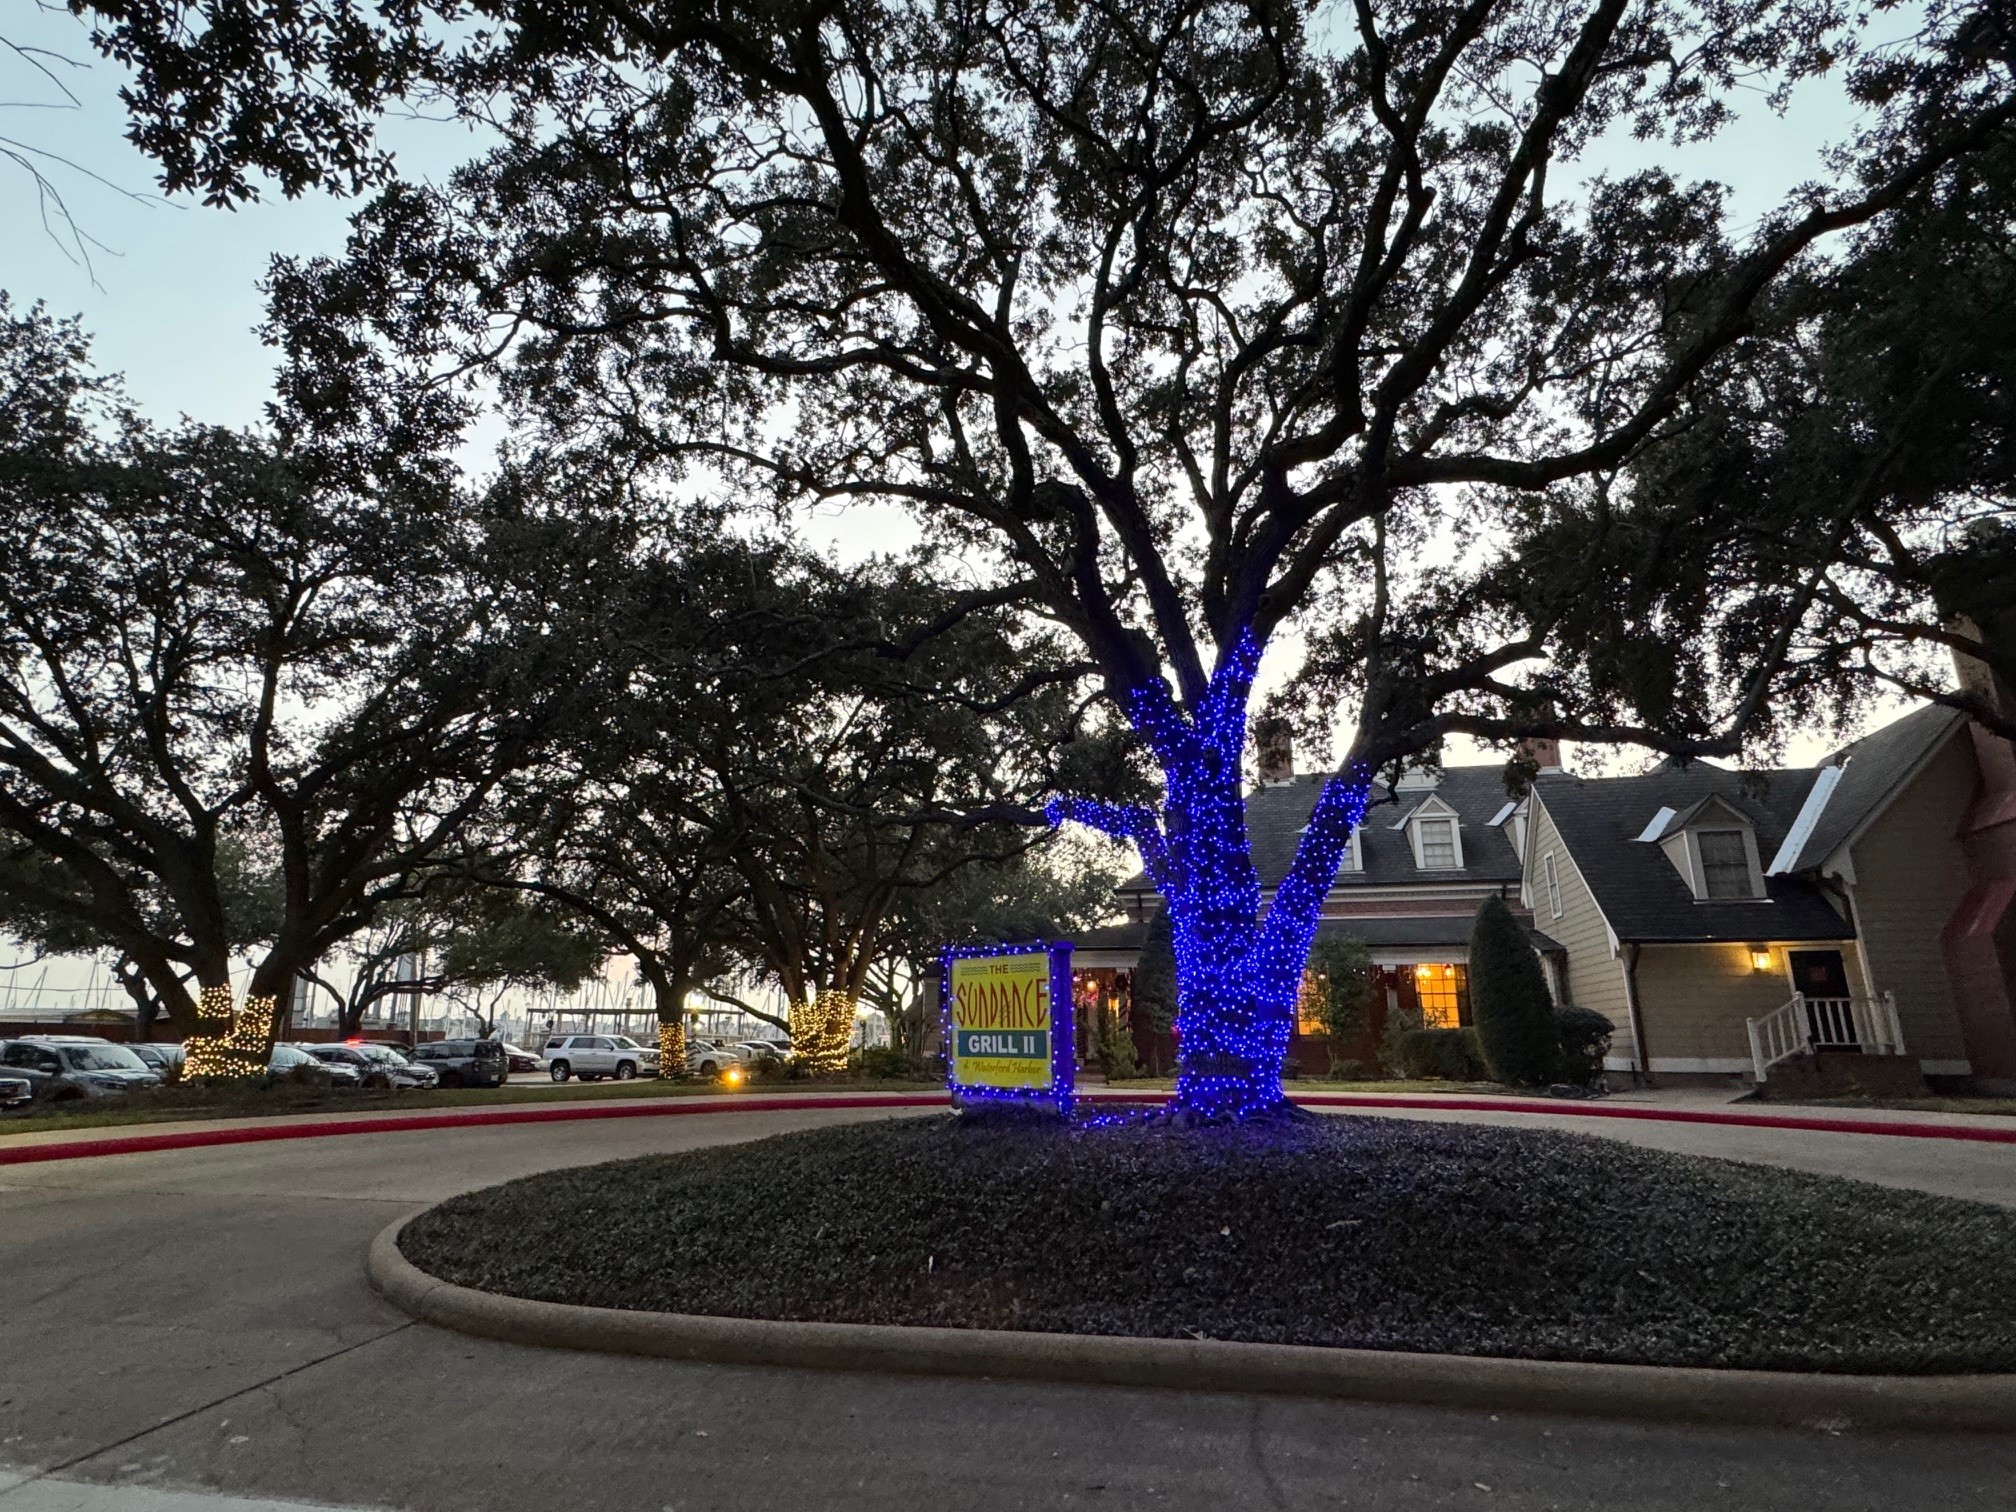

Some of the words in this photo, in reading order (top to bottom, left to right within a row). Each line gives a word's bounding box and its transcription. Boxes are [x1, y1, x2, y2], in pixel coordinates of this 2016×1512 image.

[989, 964, 1009, 974] THE
[956, 978, 1048, 1028] SUNDANCE
[968, 1035, 1018, 1054] GRILL
[1023, 1035, 1035, 1054] II
[972, 1060, 1012, 1075] Waterford
